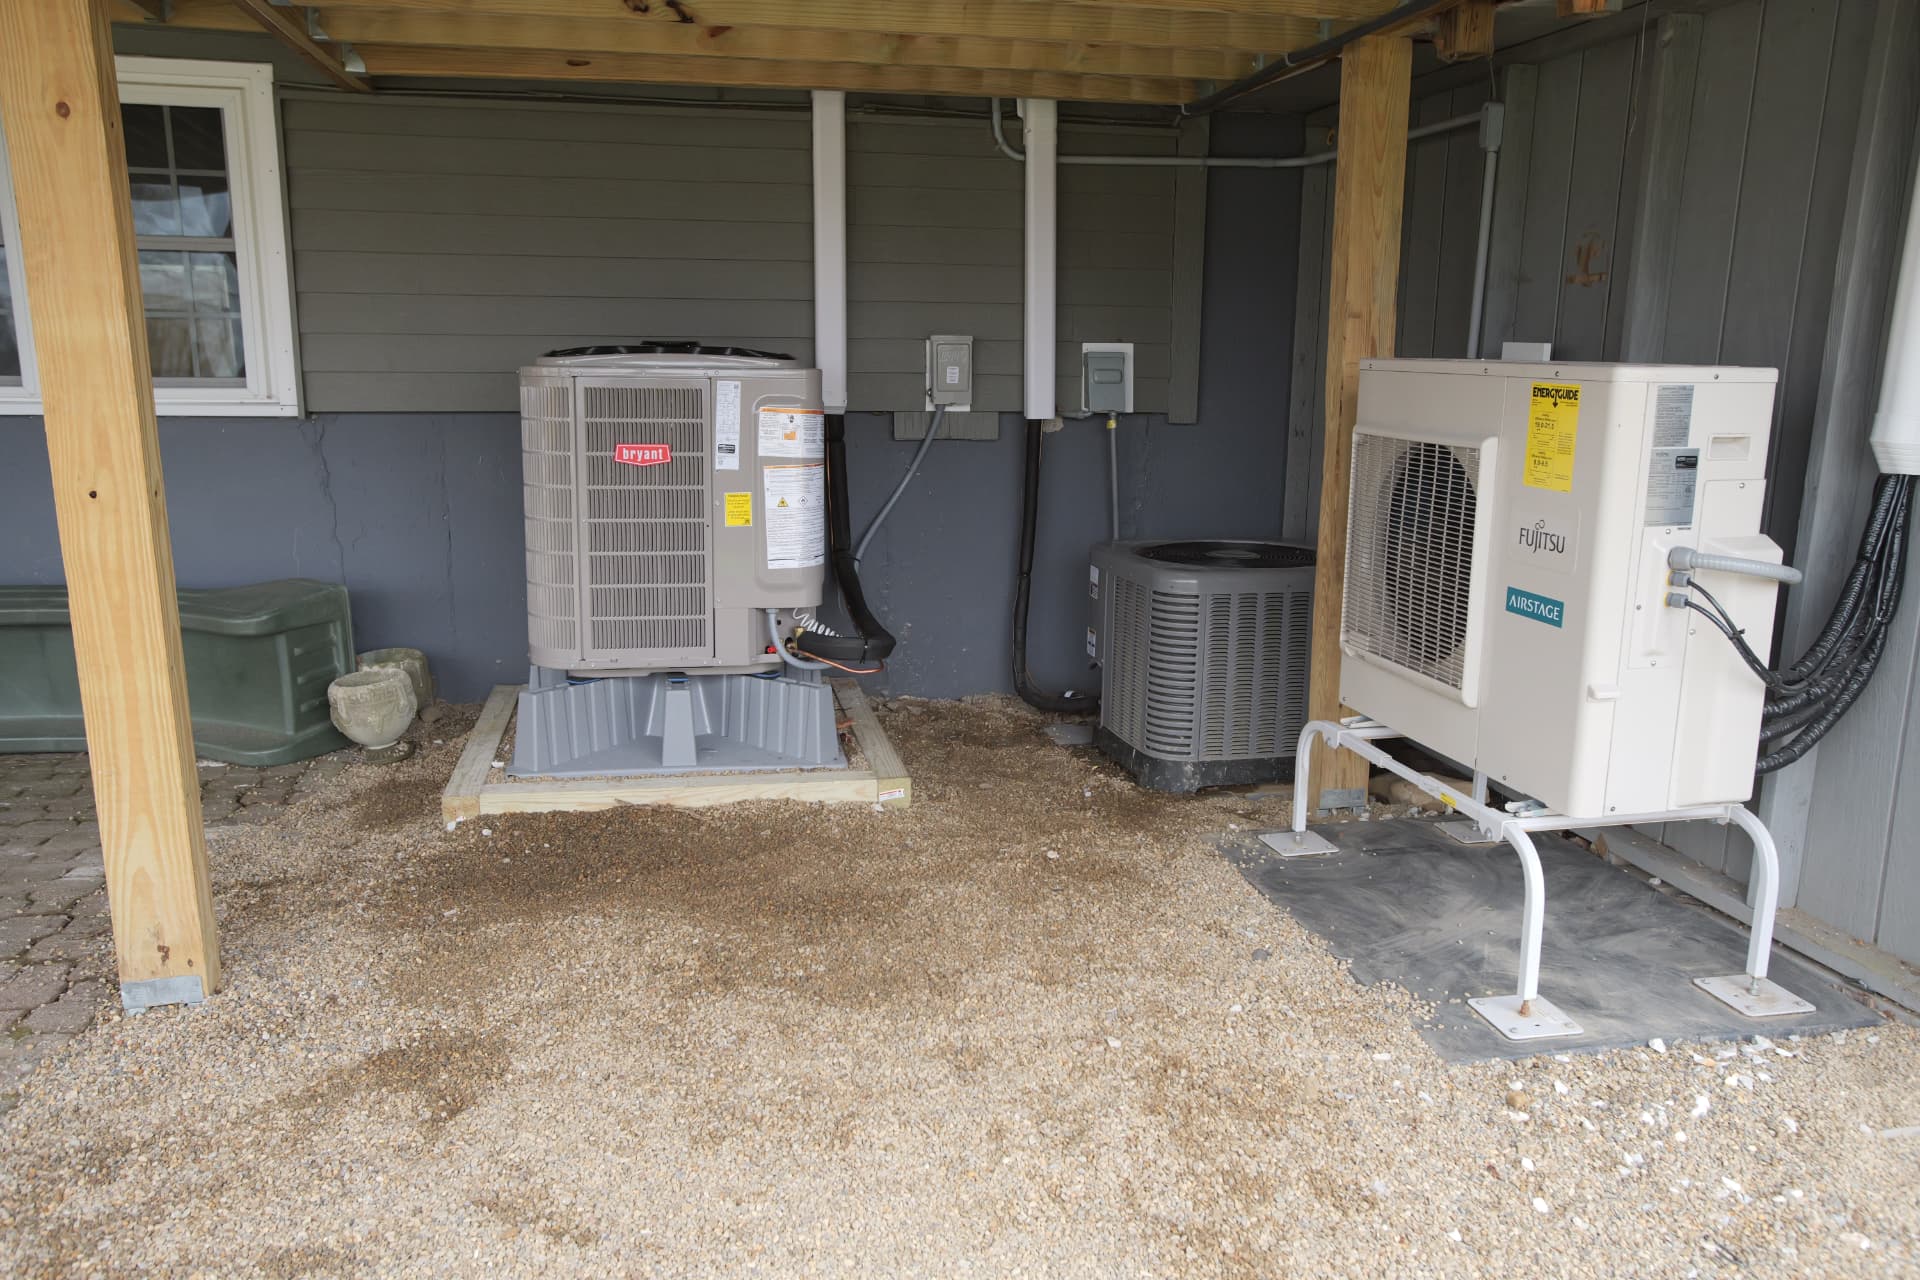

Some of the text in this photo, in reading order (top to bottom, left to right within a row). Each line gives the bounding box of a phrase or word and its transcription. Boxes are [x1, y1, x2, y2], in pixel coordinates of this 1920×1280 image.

[1532, 386, 1579, 401] ENERGYGUIDE
[622, 447, 664, 462] bryant
[1519, 527, 1566, 554] FUJITSU
[1509, 594, 1561, 621] AIRSTAGE
